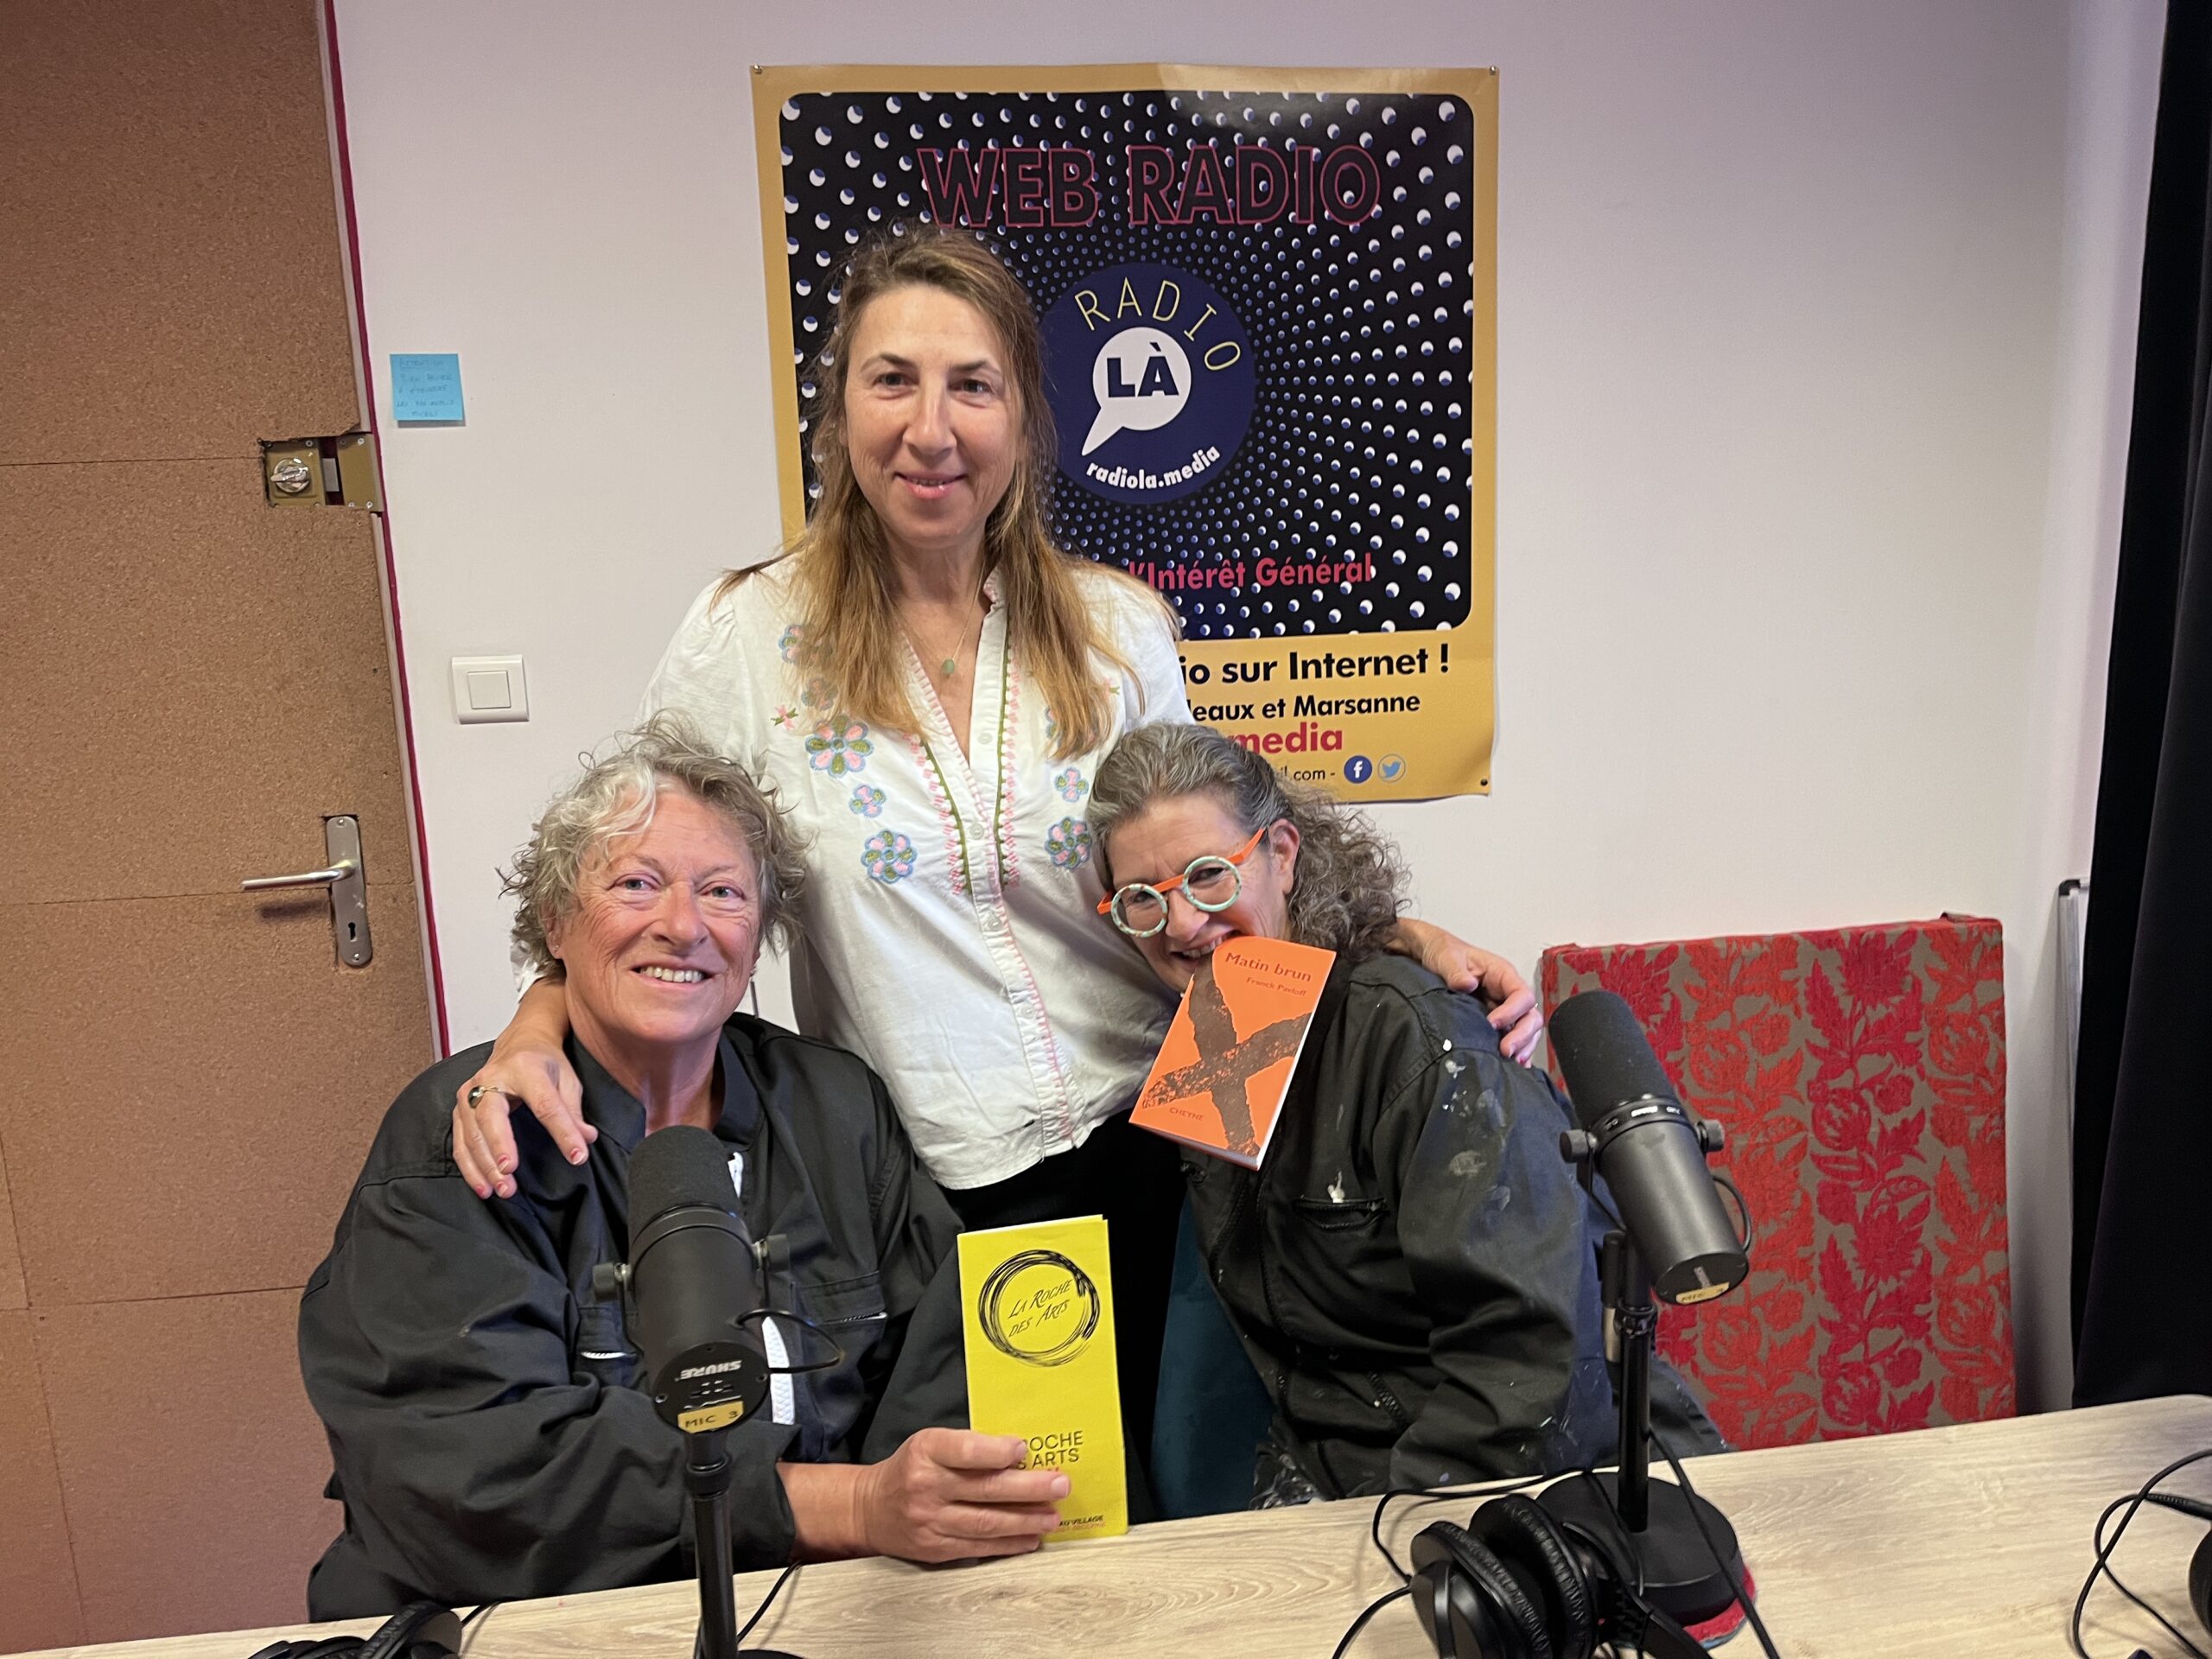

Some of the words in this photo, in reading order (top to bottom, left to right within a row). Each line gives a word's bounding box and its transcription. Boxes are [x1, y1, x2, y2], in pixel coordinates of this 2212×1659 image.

[917, 147, 1099, 229] WEB
[1128, 144, 1381, 226] RADIO
[1074, 276, 1241, 371] RADIO
[1107, 341, 1179, 398] LÀ
[1086, 446, 1221, 490] radiola.media
[1255, 552, 1372, 588] Général
[1222, 660, 1278, 683] sur
[1289, 648, 1428, 680] Internet
[1187, 699, 1255, 721] eaux
[1262, 698, 1286, 718] et
[1293, 695, 1421, 717] Marsanne
[1225, 952, 1269, 972] Matin
[1274, 963, 1312, 982] brun
[1246, 977, 1274, 989] Franck
[1277, 983, 1307, 997] Pavloff
[1029, 1279, 1073, 1309] ROCHE
[1008, 1317, 1033, 1338] DES
[1036, 1300, 1071, 1327] ARTS
[680, 1360, 742, 1380] SHURE
[685, 1414, 716, 1428] MIC
[728, 1410, 739, 1419] 3
[1022, 1431, 1084, 1452] OCHE
[1032, 1447, 1079, 1469] ARTS
